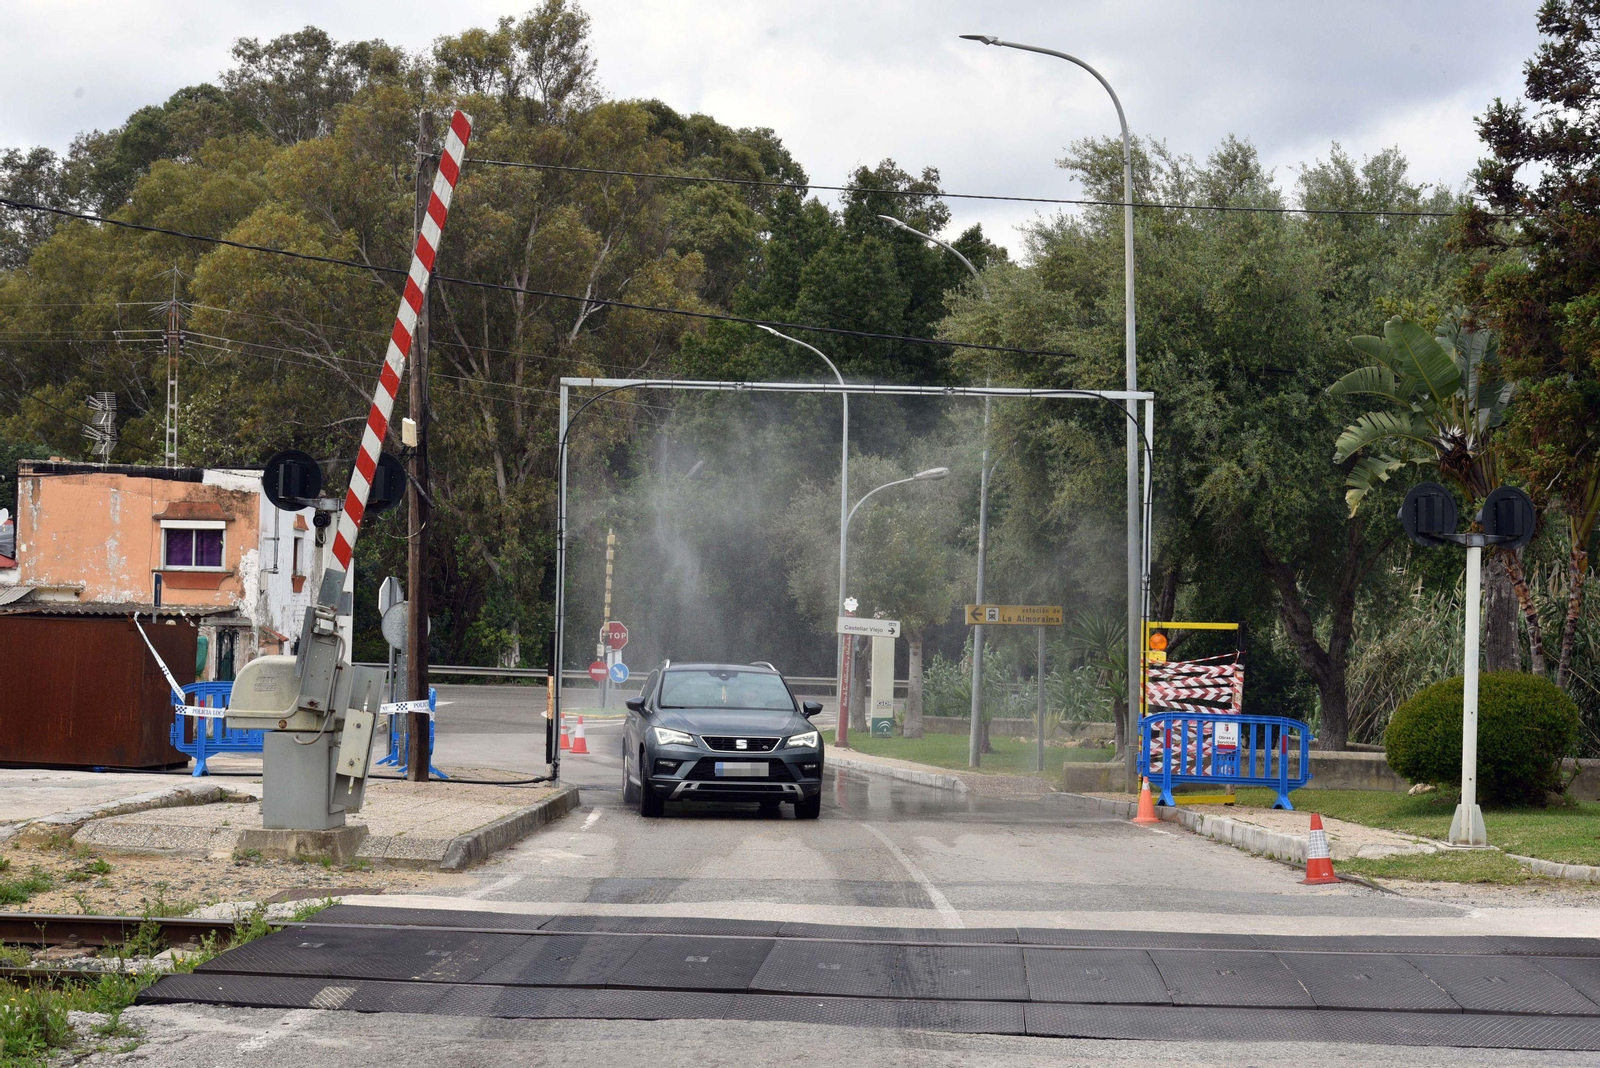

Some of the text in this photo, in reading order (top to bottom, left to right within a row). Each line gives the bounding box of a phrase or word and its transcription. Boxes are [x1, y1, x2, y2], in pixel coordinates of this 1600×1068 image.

[1016, 615, 1060, 623] Almoraima
[844, 624, 884, 634] Castellar Viejo
